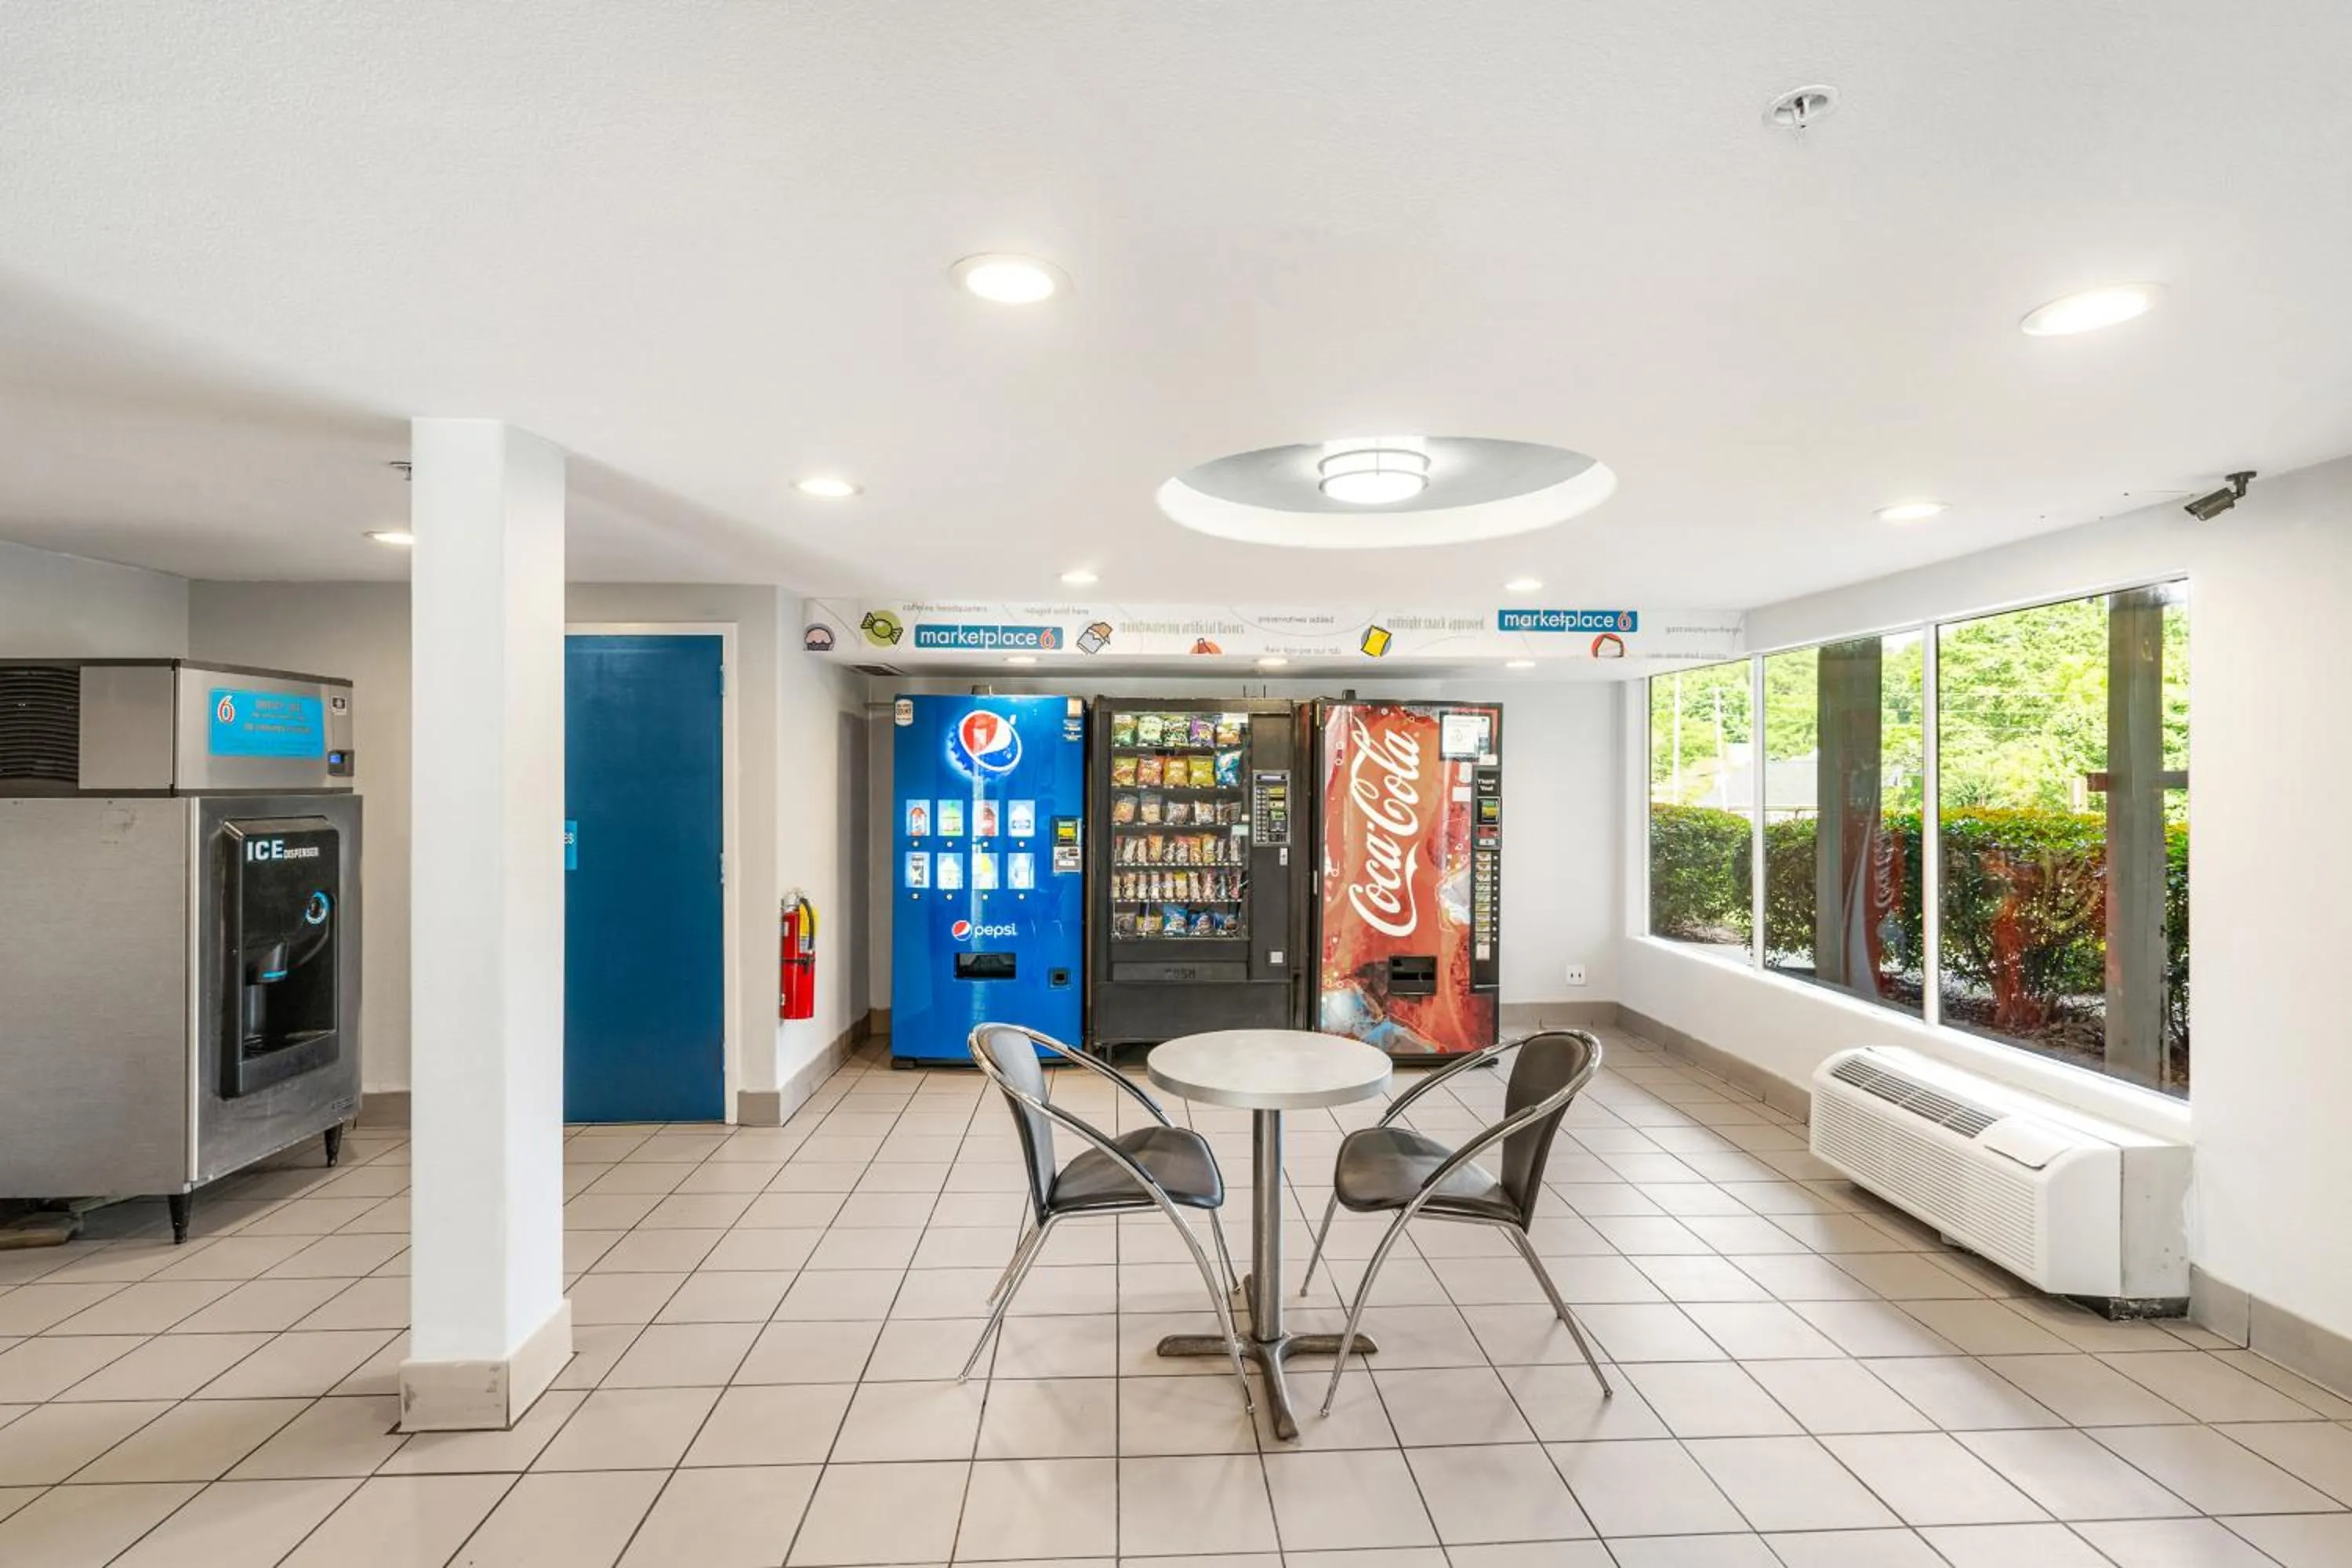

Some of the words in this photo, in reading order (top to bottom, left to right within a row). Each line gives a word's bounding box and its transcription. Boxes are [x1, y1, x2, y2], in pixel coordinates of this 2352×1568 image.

[1504, 610, 1613, 633] marketplace
[920, 624, 1037, 650] marketplace
[217, 695, 235, 723] 6
[247, 840, 284, 861] ICE
[975, 922, 1018, 938] pepsi
